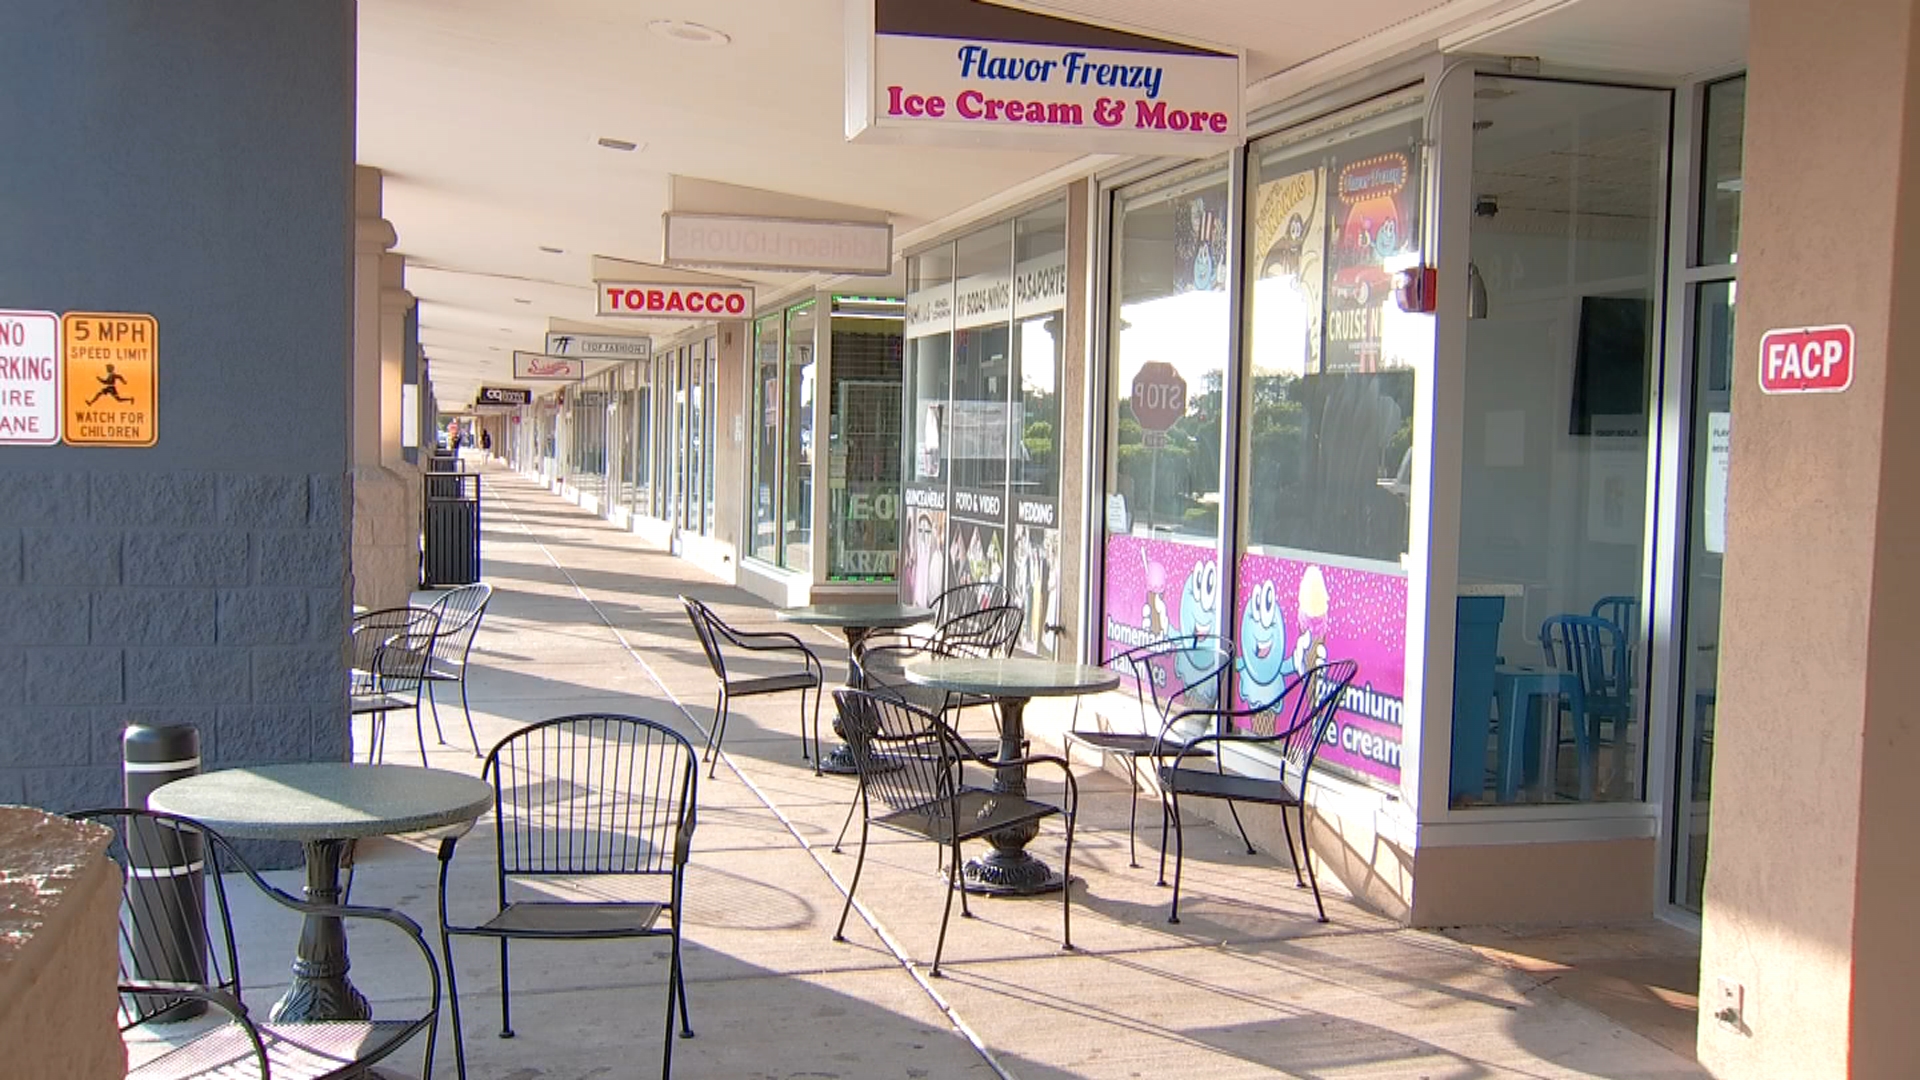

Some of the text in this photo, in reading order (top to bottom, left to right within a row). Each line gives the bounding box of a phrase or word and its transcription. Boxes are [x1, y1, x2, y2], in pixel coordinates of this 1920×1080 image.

[957, 45, 1164, 99] Flavor Frenzy
[886, 86, 1229, 134] Ice Cream & More
[606, 288, 746, 314] TOBACCO
[0, 322, 24, 347] NO
[74, 320, 145, 344] 5 MPH
[1328, 307, 1367, 341] CRUISE
[70, 346, 149, 361] SPEED LIMIT
[1767, 340, 1843, 381] FACP
[0, 356, 53, 381] RKING
[2, 390, 36, 407] IRE
[0, 416, 39, 433] ANE
[75, 411, 145, 425] WATCH FOR
[79, 426, 140, 439] CHILDREN
[955, 491, 1001, 515] FOTO & VIDEO
[1018, 501, 1053, 524] WEDDING
[1149, 660, 1166, 687] ce
[1315, 680, 1404, 726] prmium
[1342, 726, 1402, 767] cream
